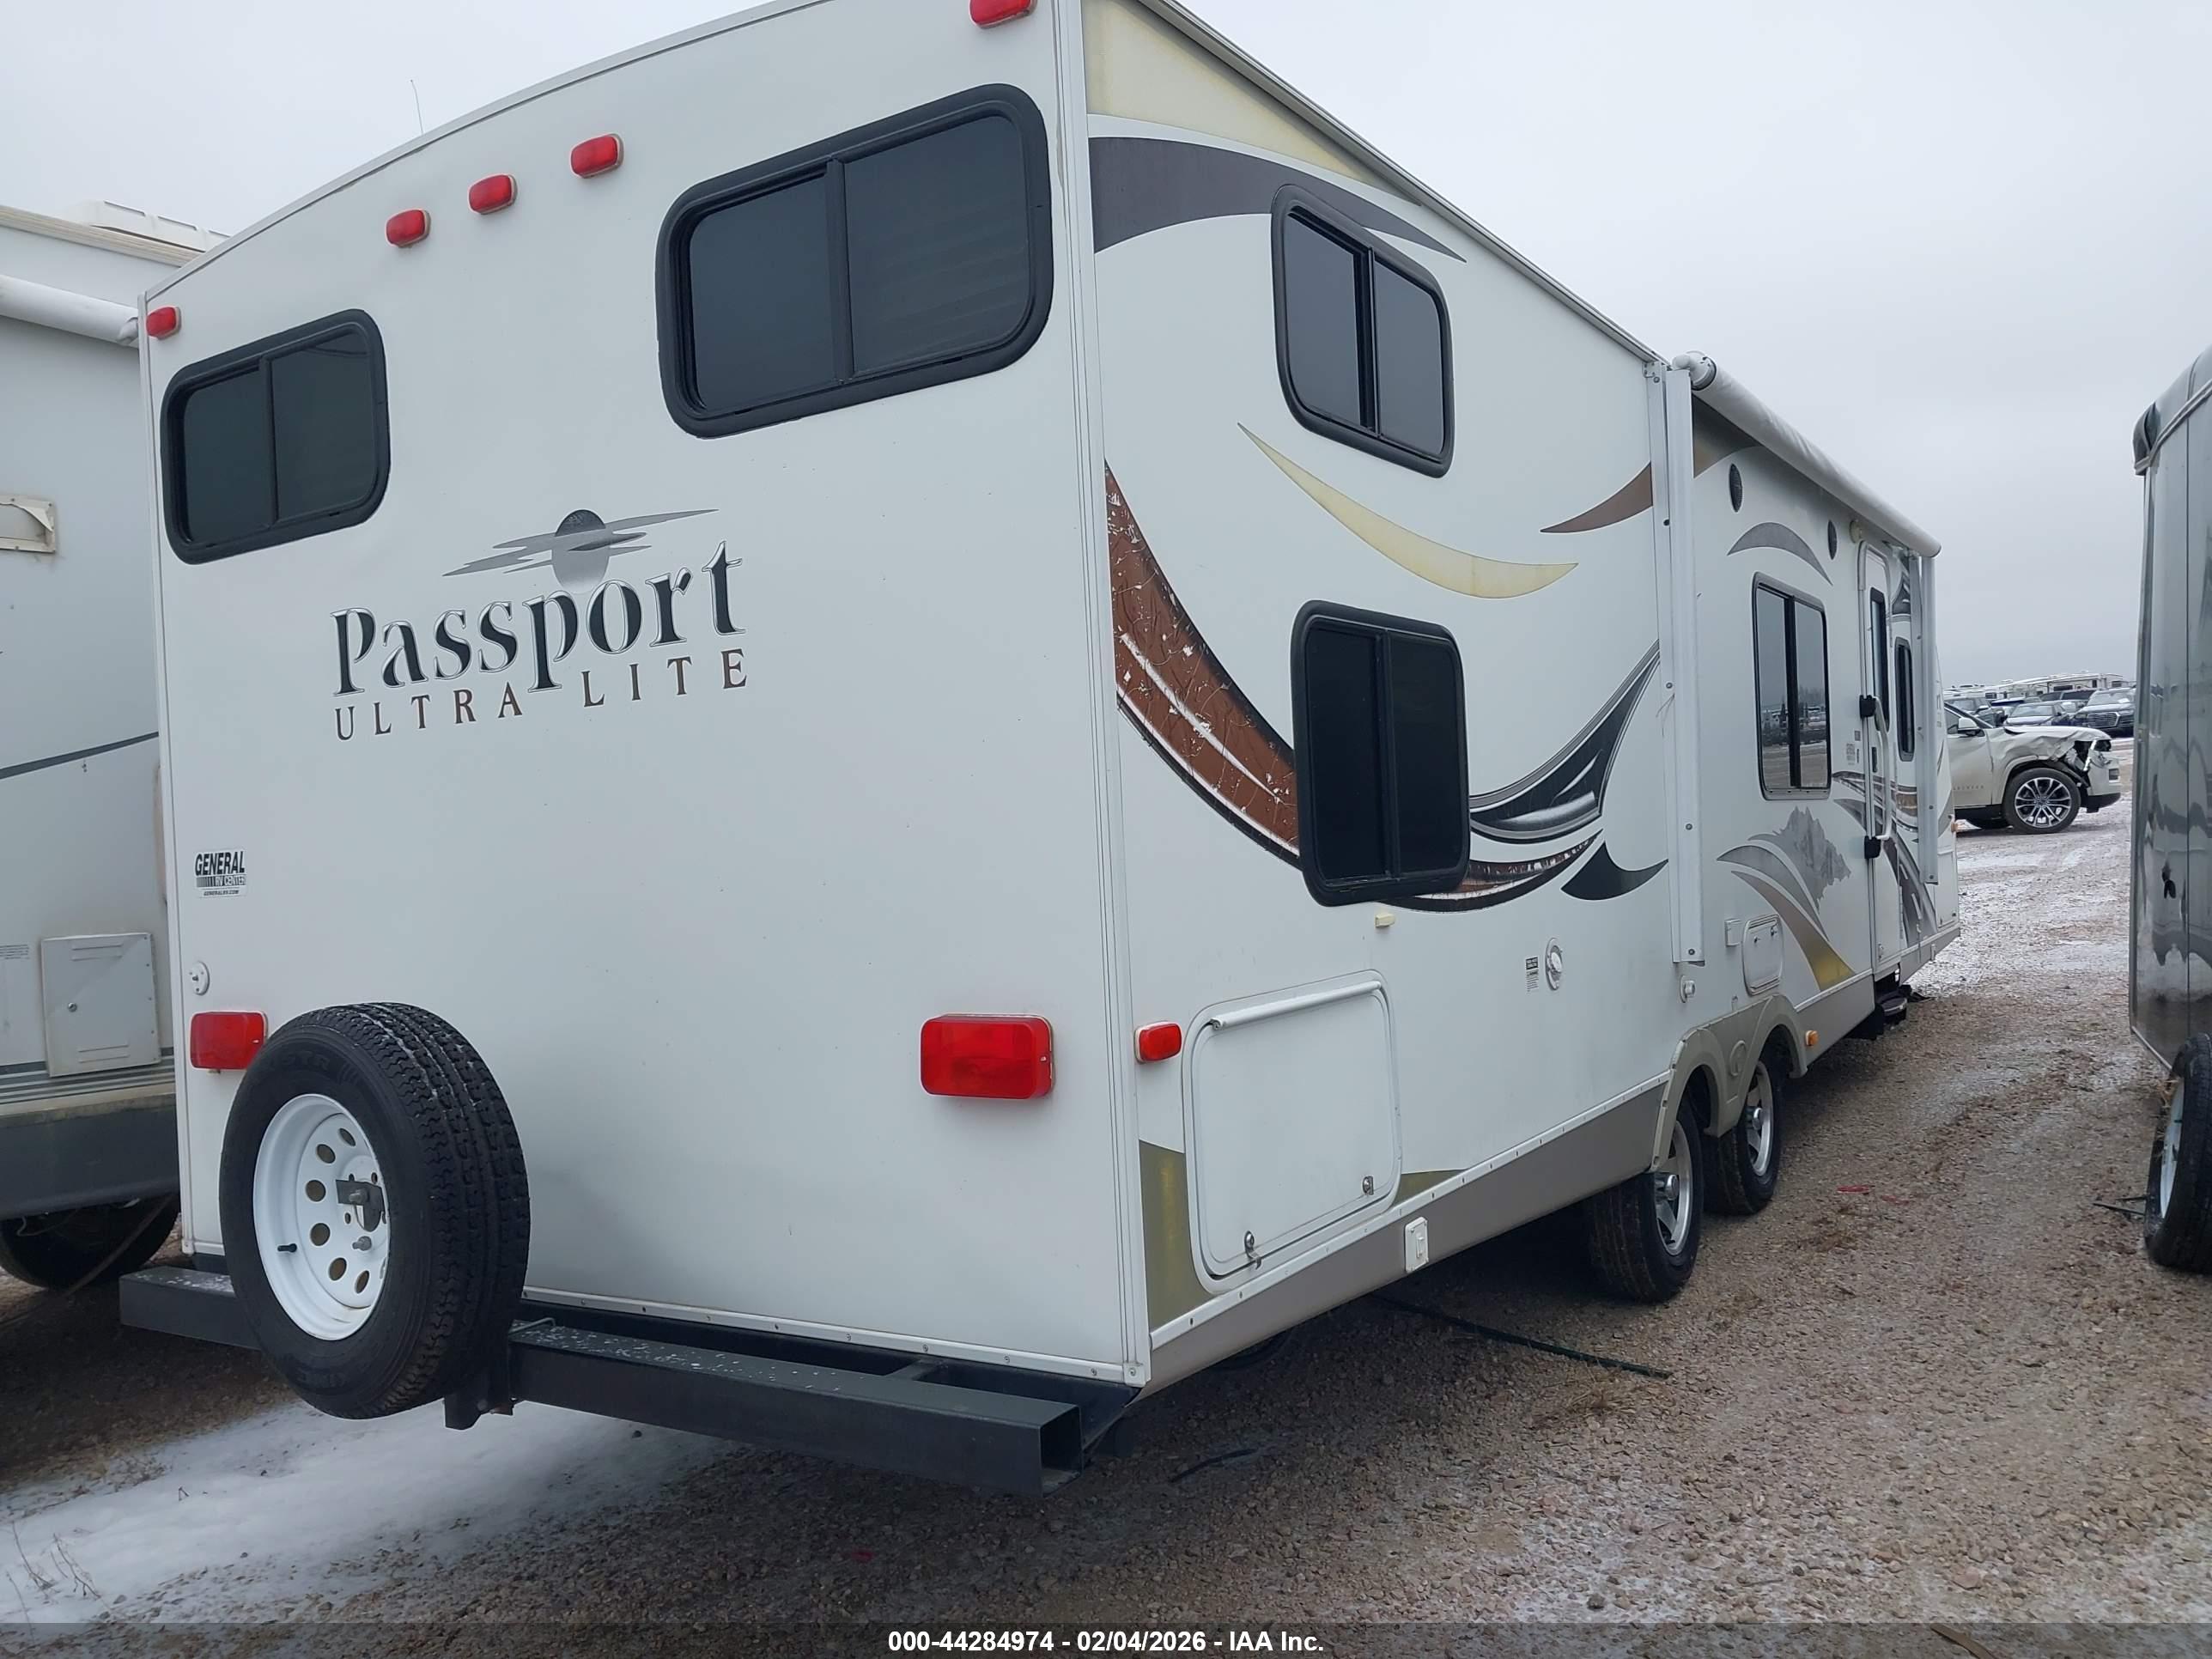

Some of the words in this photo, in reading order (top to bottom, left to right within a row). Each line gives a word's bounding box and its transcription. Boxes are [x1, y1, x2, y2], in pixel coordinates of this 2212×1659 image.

[331, 540, 746, 696] Passport
[334, 682, 522, 741] ULTRA
[580, 648, 748, 708] LITE
[195, 851, 246, 876] GENERAL
